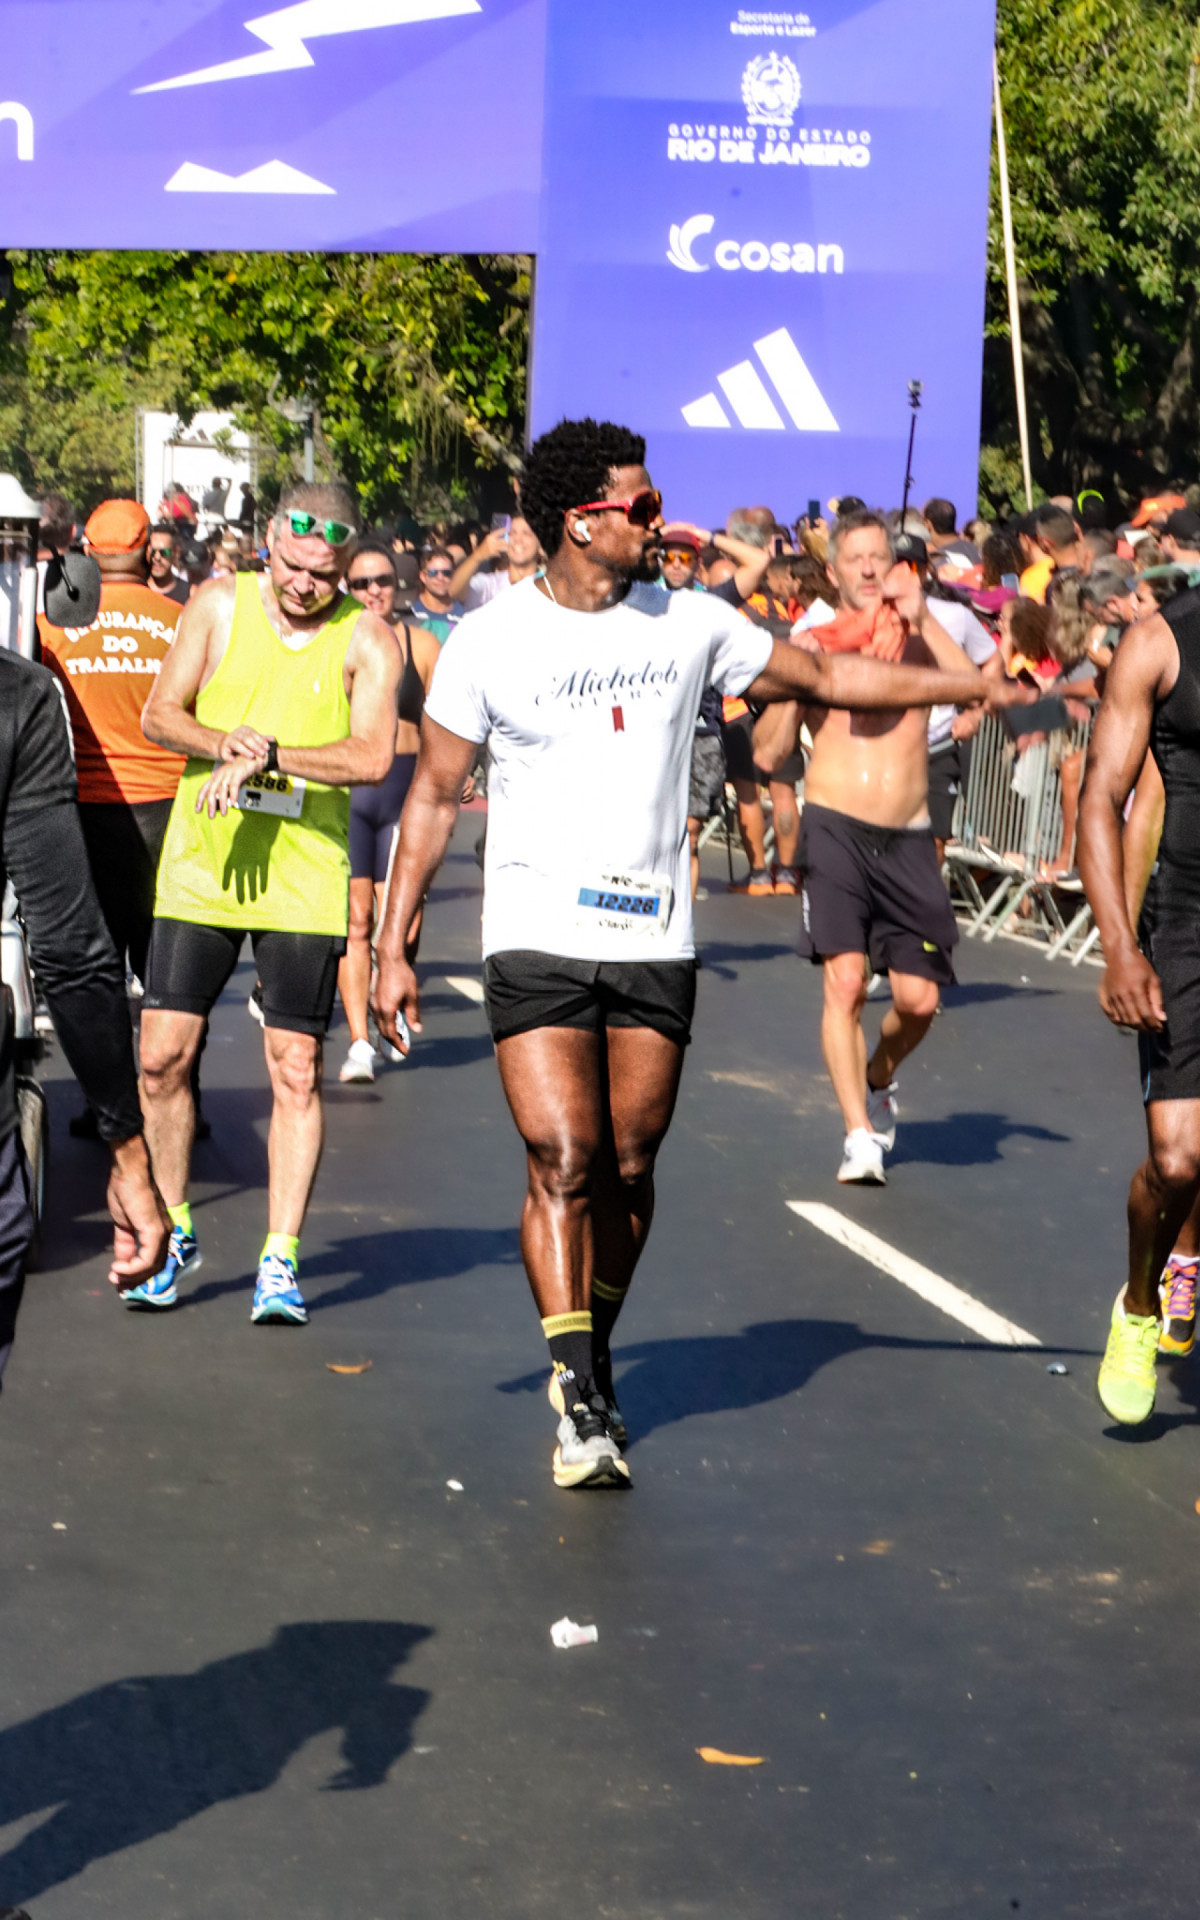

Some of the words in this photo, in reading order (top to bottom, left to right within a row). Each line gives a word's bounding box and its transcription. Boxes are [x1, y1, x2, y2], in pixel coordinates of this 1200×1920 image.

[737, 10, 794, 26] Secretaria
[730, 21, 775, 36] Esporte
[785, 24, 817, 37] Lazer
[668, 123, 758, 141] GOVERNO
[766, 127, 791, 142] DO
[799, 128, 872, 145] ESTADO
[668, 138, 717, 162] RIO
[719, 140, 755, 164] DE
[758, 141, 871, 167] JANEIRO
[714, 240, 844, 274] cosan
[102, 635, 138, 653] DO
[65, 656, 162, 674] TRABALH
[536, 660, 678, 705] Michelob
[244, 772, 288, 793] 586
